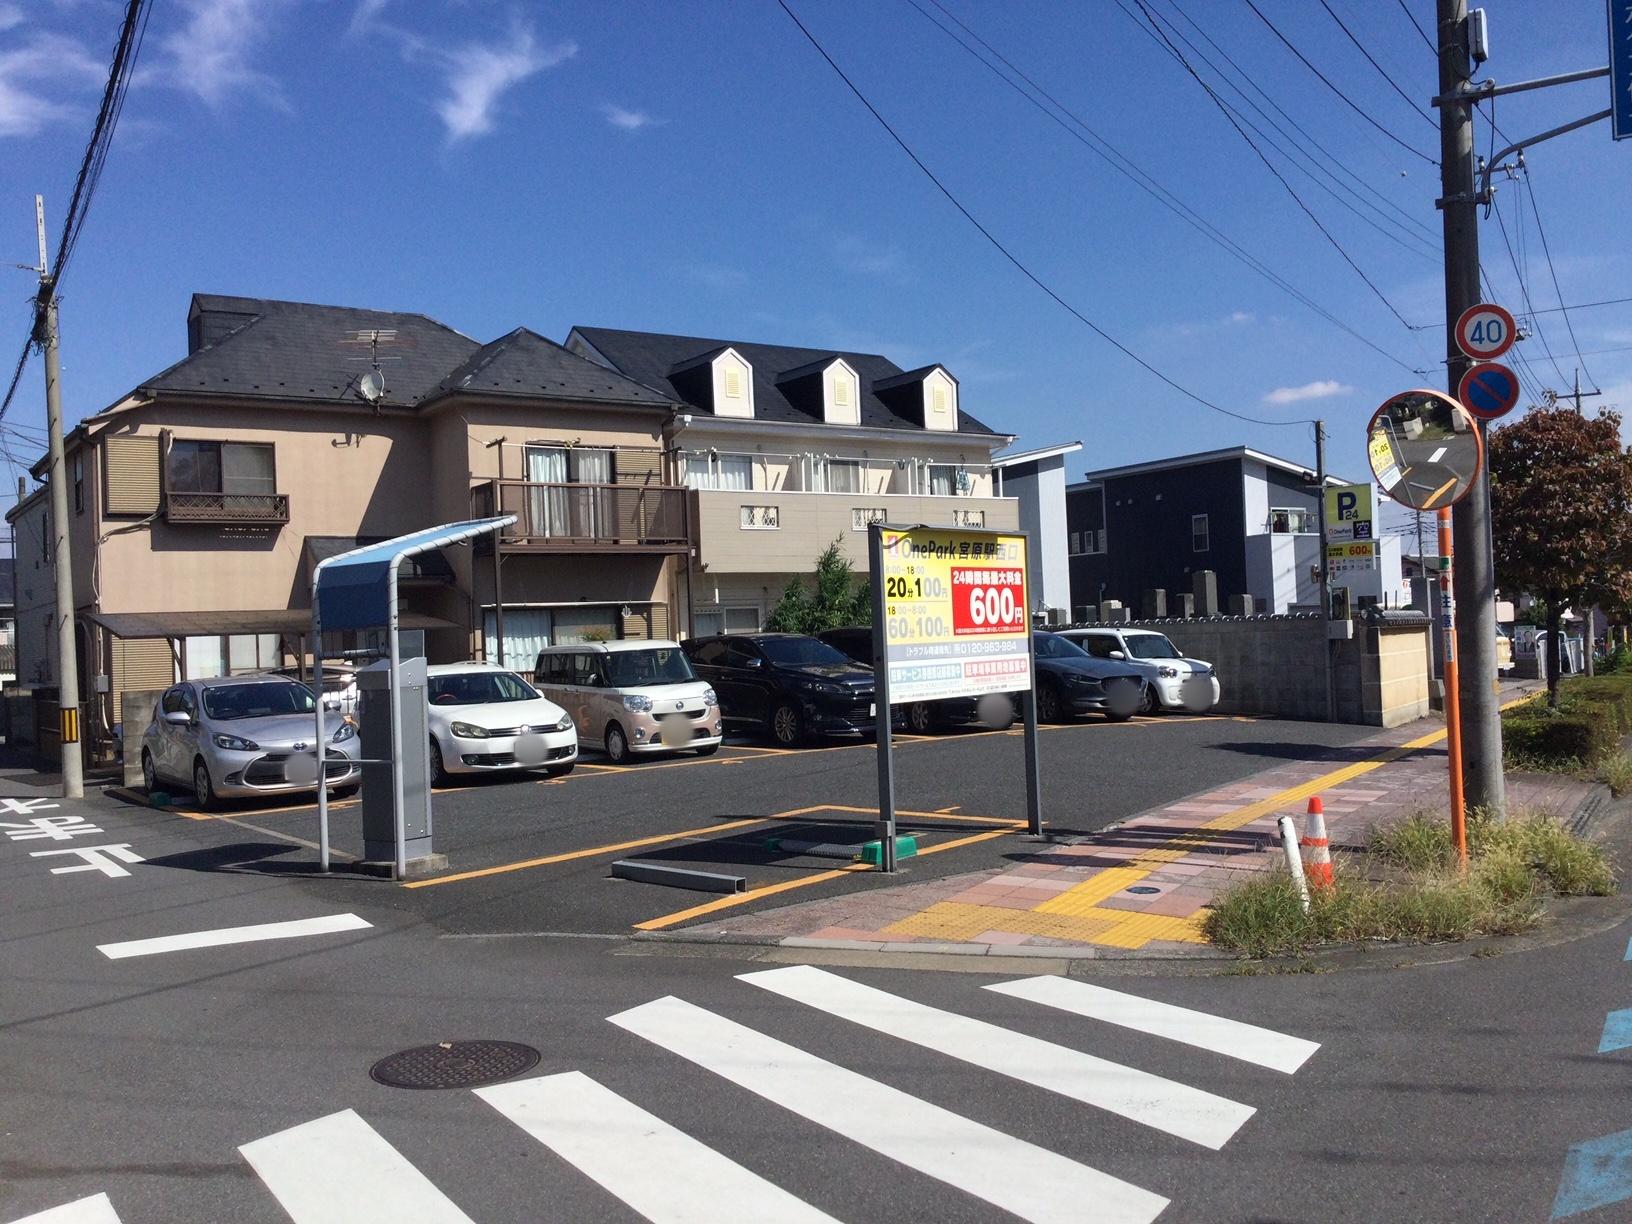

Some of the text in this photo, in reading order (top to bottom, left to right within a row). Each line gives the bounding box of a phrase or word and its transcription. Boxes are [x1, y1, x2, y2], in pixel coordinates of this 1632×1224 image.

[1470, 319, 1502, 345] 40
[901, 538, 1019, 561] OnePark 宮原駅西口
